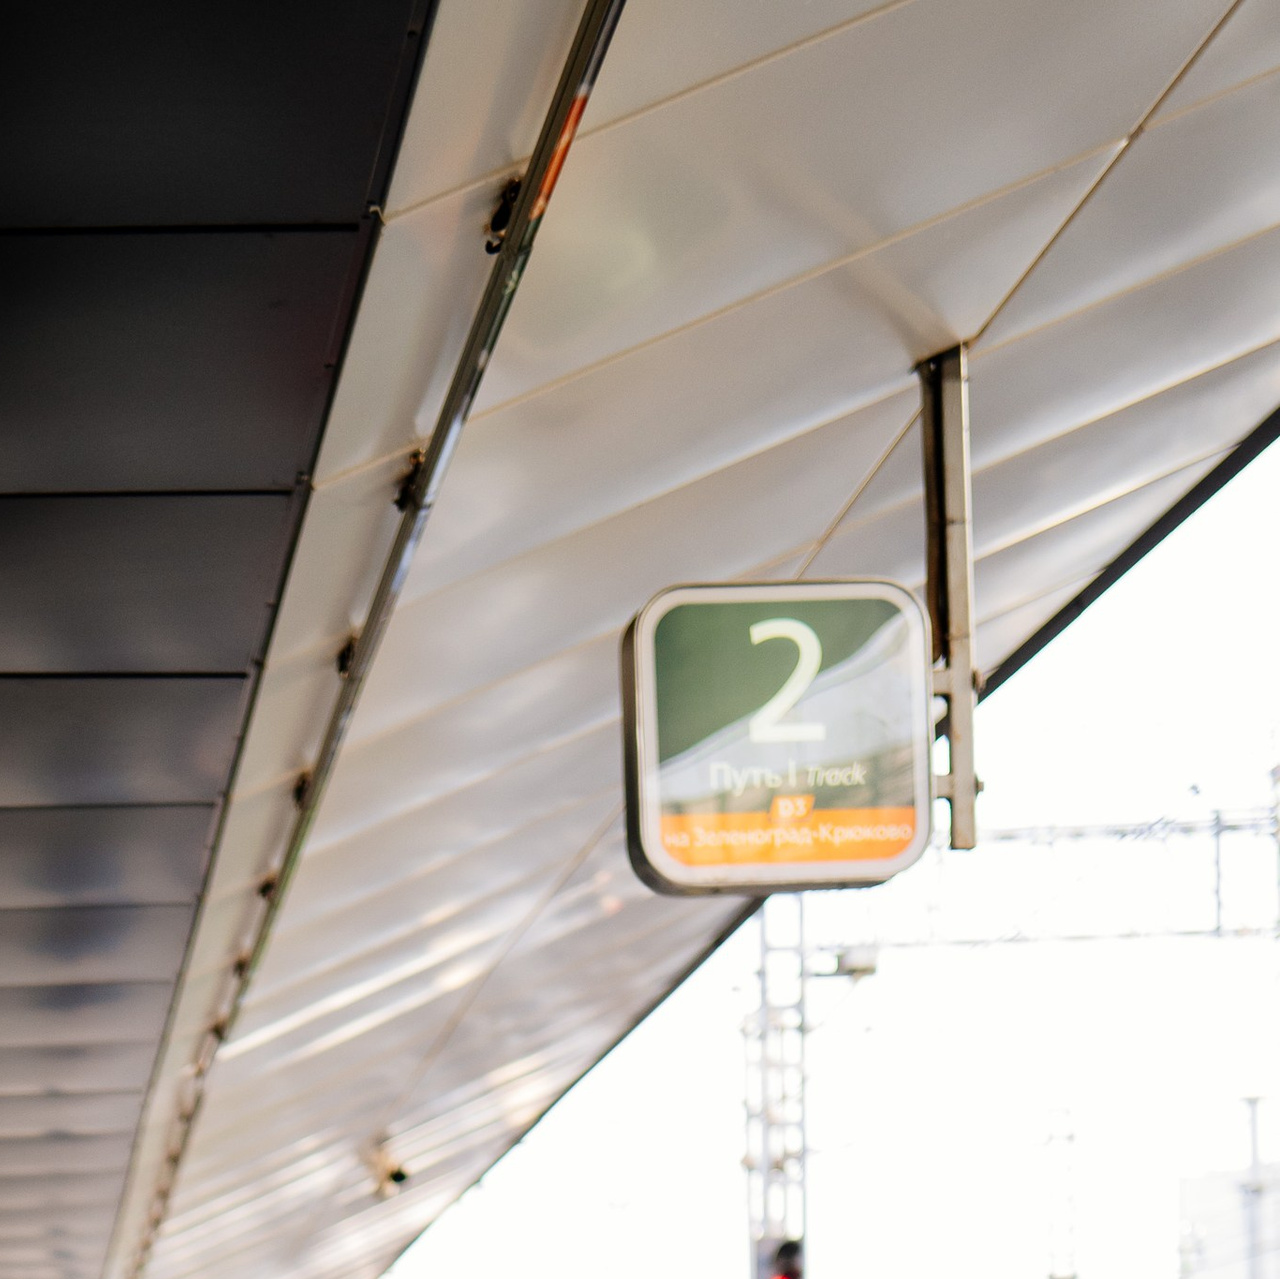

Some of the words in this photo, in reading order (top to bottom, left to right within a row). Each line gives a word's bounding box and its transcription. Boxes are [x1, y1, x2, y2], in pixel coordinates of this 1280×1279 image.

[749, 617, 827, 743] 2
[708, 761, 783, 797] Путь
[806, 761, 867, 787] Track
[777, 797, 807, 818] D3
[664, 832, 690, 849] на
[693, 820, 913, 849] Зеленоград-Крюково
